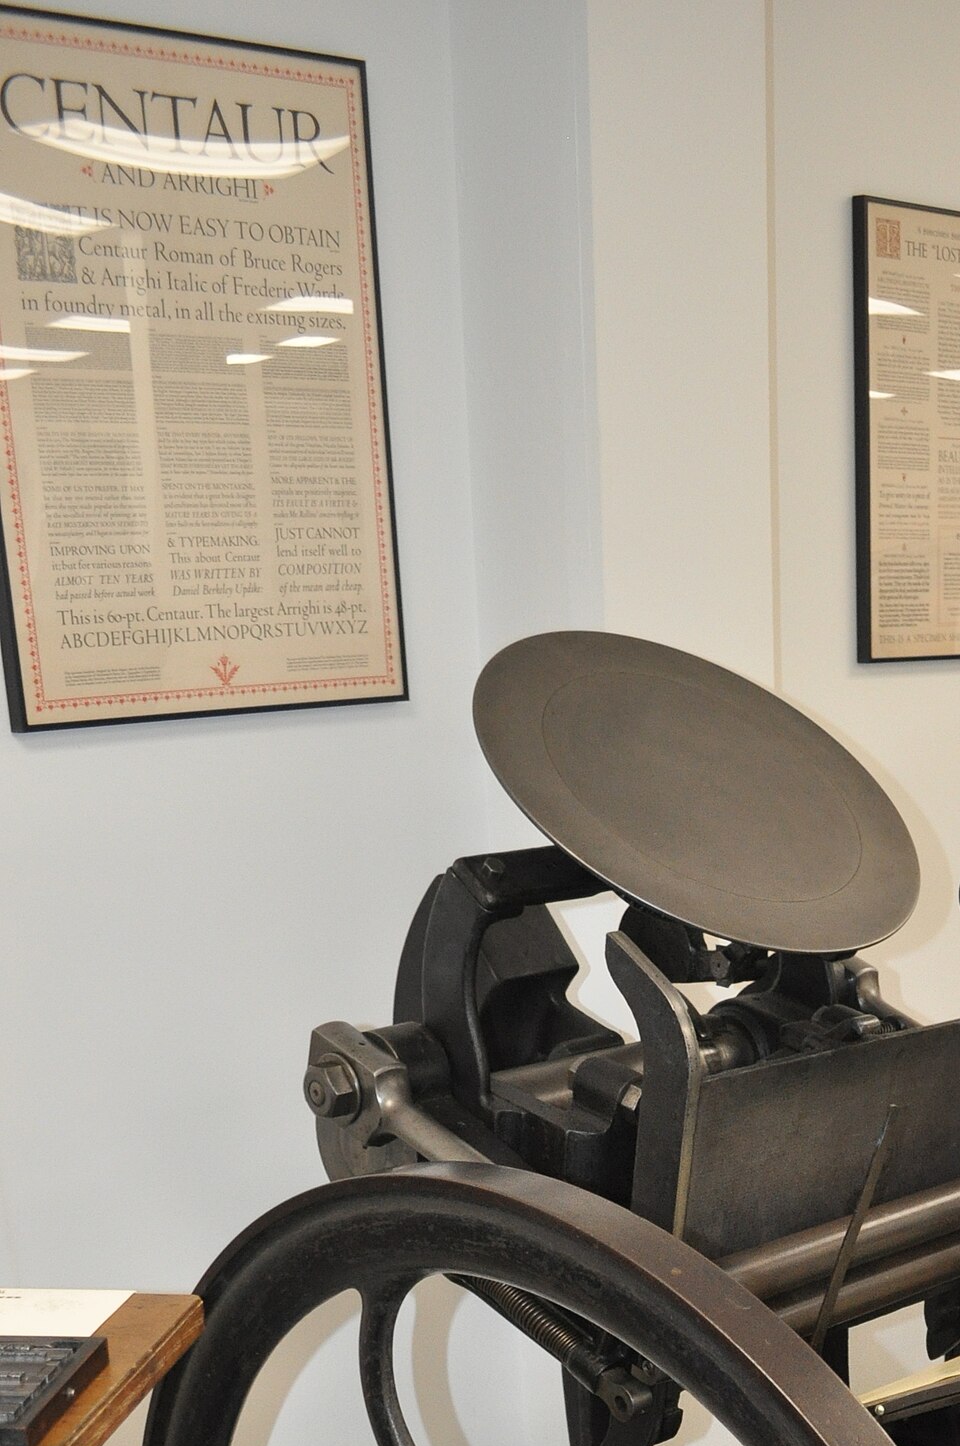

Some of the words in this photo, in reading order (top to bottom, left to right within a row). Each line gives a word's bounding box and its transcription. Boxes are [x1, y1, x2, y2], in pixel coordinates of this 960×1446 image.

[1, 73, 334, 174] CENTAUR
[101, 164, 155, 188] AND
[163, 173, 260, 199] ARRIGHI
[117, 209, 173, 233] NOW
[179, 215, 230, 239] EASY
[234, 220, 264, 242] TO
[268, 224, 341, 248] OBTAIN
[904, 240, 928, 257] THE
[78, 235, 148, 260] Centaur
[154, 242, 214, 265] Roman
[219, 247, 238, 267] of
[243, 249, 286, 271] Bruce
[291, 254, 343, 282] Rogers
[81, 266, 96, 285] &
[101, 267, 161, 296] Arrighi
[166, 271, 207, 293] Italic
[211, 274, 230, 294] of
[233, 276, 295, 299] Frederic
[297, 282, 344, 301] Warde
[21, 291, 39, 311] in
[45, 291, 114, 317] foundry
[120, 299, 172, 320] metal,
[175, 300, 190, 320] in
[195, 301, 215, 321] all
[219, 303, 243, 323] the
[246, 311, 305, 334] existing
[308, 311, 347, 330] sizes.
[167, 538, 176, 548] &
[275, 527, 304, 543] JUST
[306, 527, 361, 540] CANNOT
[50, 545, 116, 556] IMPROVING
[119, 544, 151, 555] UPON
[168, 552, 192, 563] This
[195, 551, 221, 563] about
[225, 551, 261, 562] Centaur
[276, 544, 298, 557] lend
[301, 543, 327, 556] itself
[328, 543, 348, 556] well
[351, 547, 362, 556] to
[170, 569, 191, 580] WAS
[194, 568, 246, 579] WRITTEN
[249, 567, 263, 578] BY
[278, 562, 362, 576] COMPOSITION
[54, 575, 94, 586] ALMOST
[99, 574, 122, 584] TEN
[125, 573, 154, 583] YEARS
[57, 609, 91, 626] This
[93, 609, 105, 624] is
[146, 606, 204, 622] Centaur.
[205, 603, 232, 619] The
[234, 602, 274, 623] largest
[277, 600, 320, 620] Arrighi
[323, 601, 333, 614] is
[60, 620, 368, 650] ABCDEFGHIJKLMNOPQRSTUVWXYZ
